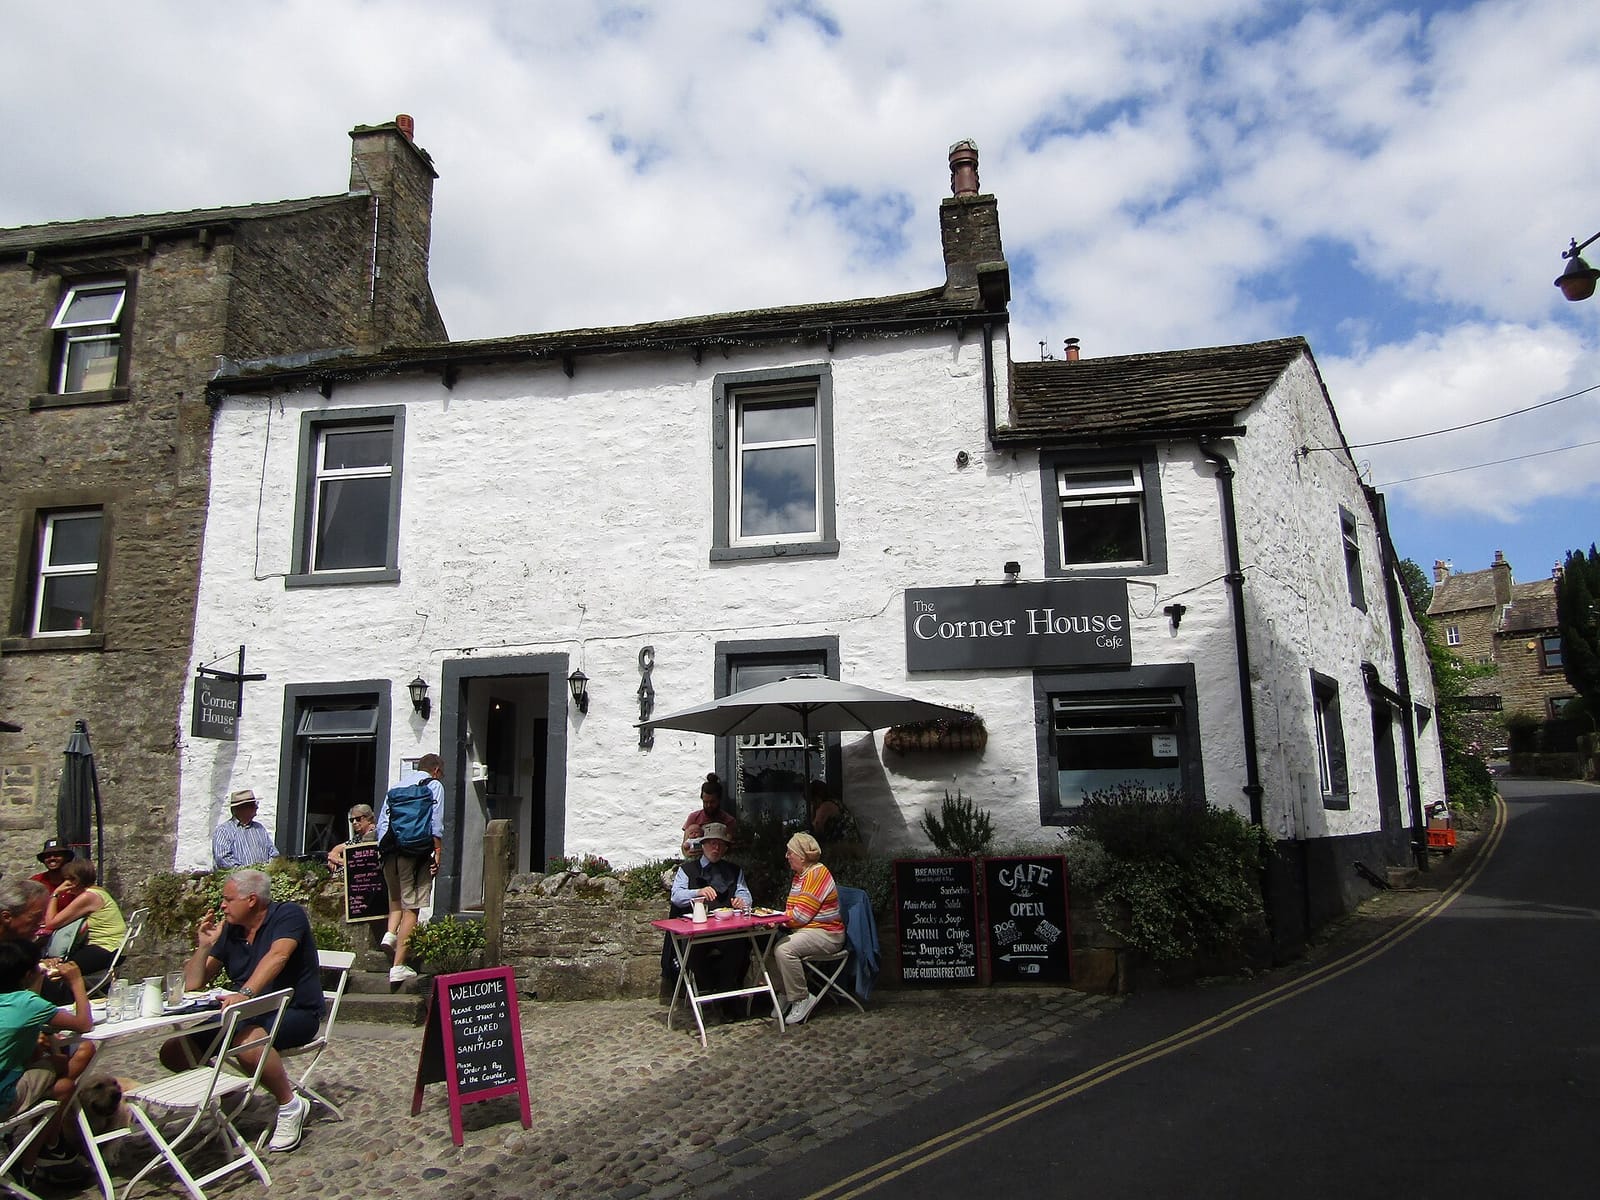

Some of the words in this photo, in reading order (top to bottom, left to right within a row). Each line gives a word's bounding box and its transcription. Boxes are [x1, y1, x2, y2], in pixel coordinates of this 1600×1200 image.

[912, 600, 935, 613] The
[912, 613, 1017, 641] Corner
[1025, 608, 1122, 636] House
[1095, 634, 1124, 650] Cafe
[201, 691, 238, 710] Corner
[201, 707, 234, 725] House
[914, 867, 954, 877] BREAKFAST
[998, 863, 1053, 891] CAFE
[903, 900, 919, 910] Main
[919, 900, 937, 909] Meals
[1009, 902, 1045, 917] OPEN
[912, 913, 937, 925] Snacks
[944, 913, 963, 926] Soup
[993, 919, 1016, 934] DOG
[906, 928, 939, 940] PANINI
[946, 928, 970, 943] Chips
[1035, 925, 1058, 943] BOOTS
[919, 943, 954, 959] Burgers
[1012, 944, 1048, 953] ENTRANCE
[903, 968, 919, 979] HUGE
[920, 967, 941, 978] GLUTEN
[941, 967, 954, 978] FREE
[955, 966, 975, 978] CHOICE
[450, 980, 503, 1001] WELCOME
[451, 1005, 473, 1015] PLEASE
[475, 1002, 496, 1010] CHOOSE
[453, 1017, 473, 1026] TABLE
[477, 1013, 493, 1021] THAT
[463, 1022, 499, 1036] CLEARED
[477, 1034, 483, 1042] &
[457, 1039, 503, 1054] SANITISED
[463, 1066, 480, 1075] Order
[492, 1061, 502, 1071] Pay
[460, 1077, 466, 1085] at
[481, 1071, 507, 1081] Counter
